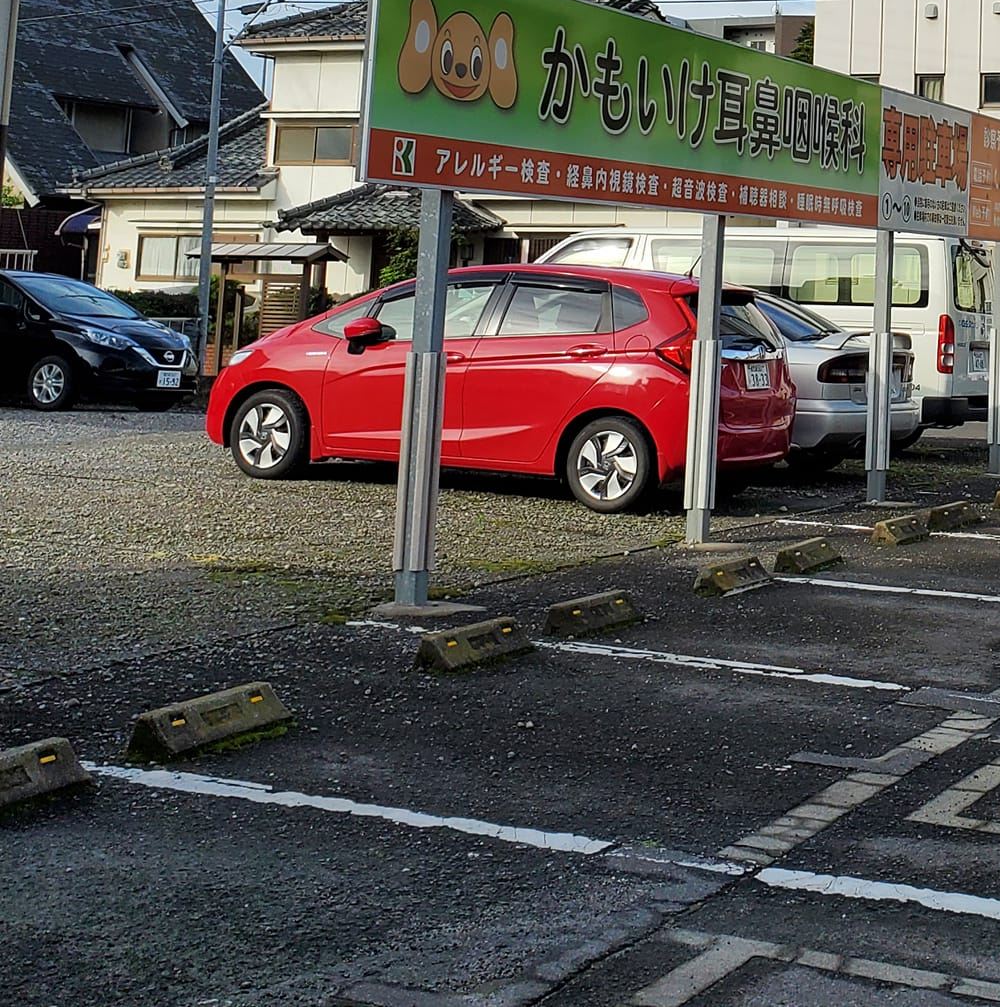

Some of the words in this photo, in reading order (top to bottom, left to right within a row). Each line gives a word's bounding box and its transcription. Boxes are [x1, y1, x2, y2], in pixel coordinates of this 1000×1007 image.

[538, 25, 867, 175] かもいけ耳鼻咽喉科
[881, 104, 969, 192] 専用駐車場
